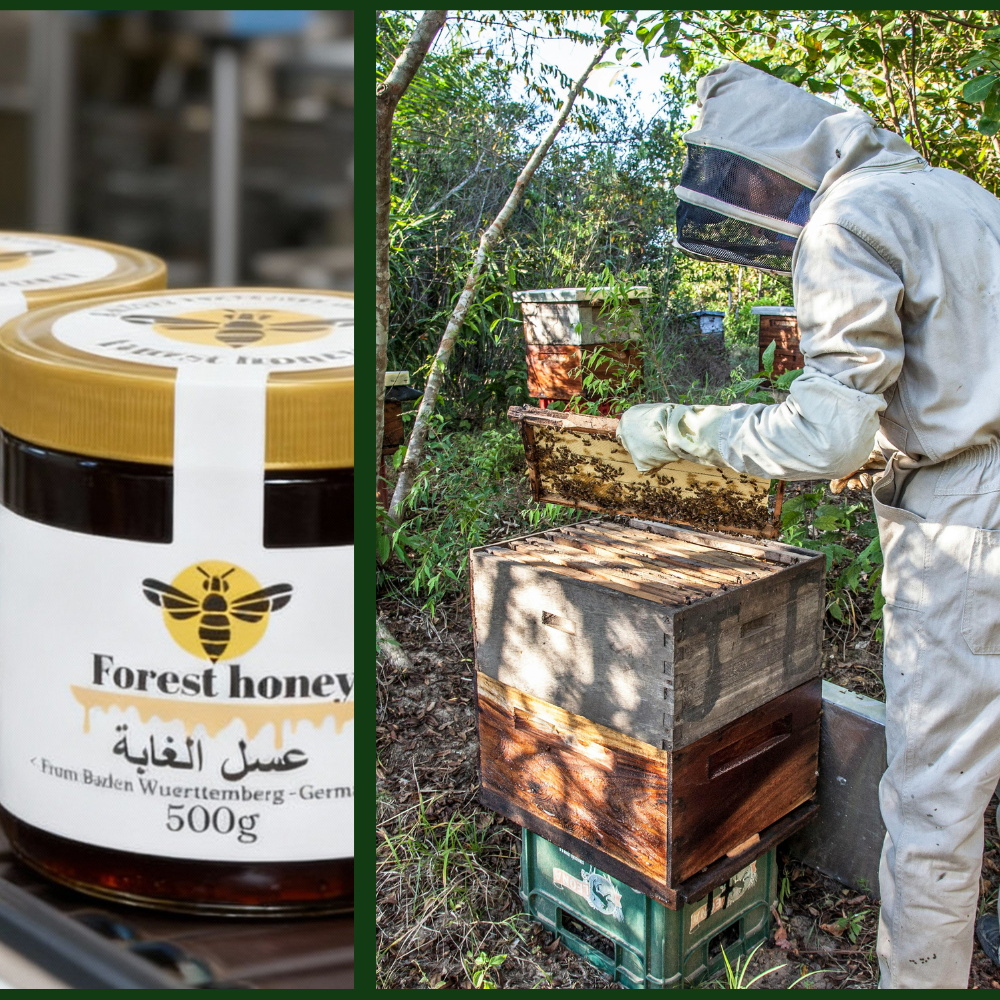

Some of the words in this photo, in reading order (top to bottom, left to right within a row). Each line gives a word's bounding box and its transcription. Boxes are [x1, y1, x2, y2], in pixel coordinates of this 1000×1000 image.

[90, 653, 219, 698] Forest
[228, 664, 354, 704] honey
[112, 725, 202, 775] الغابة
[220, 738, 309, 782] عسل
[138, 778, 285, 805] Wuerttemberg
[165, 804, 260, 844] 500g
